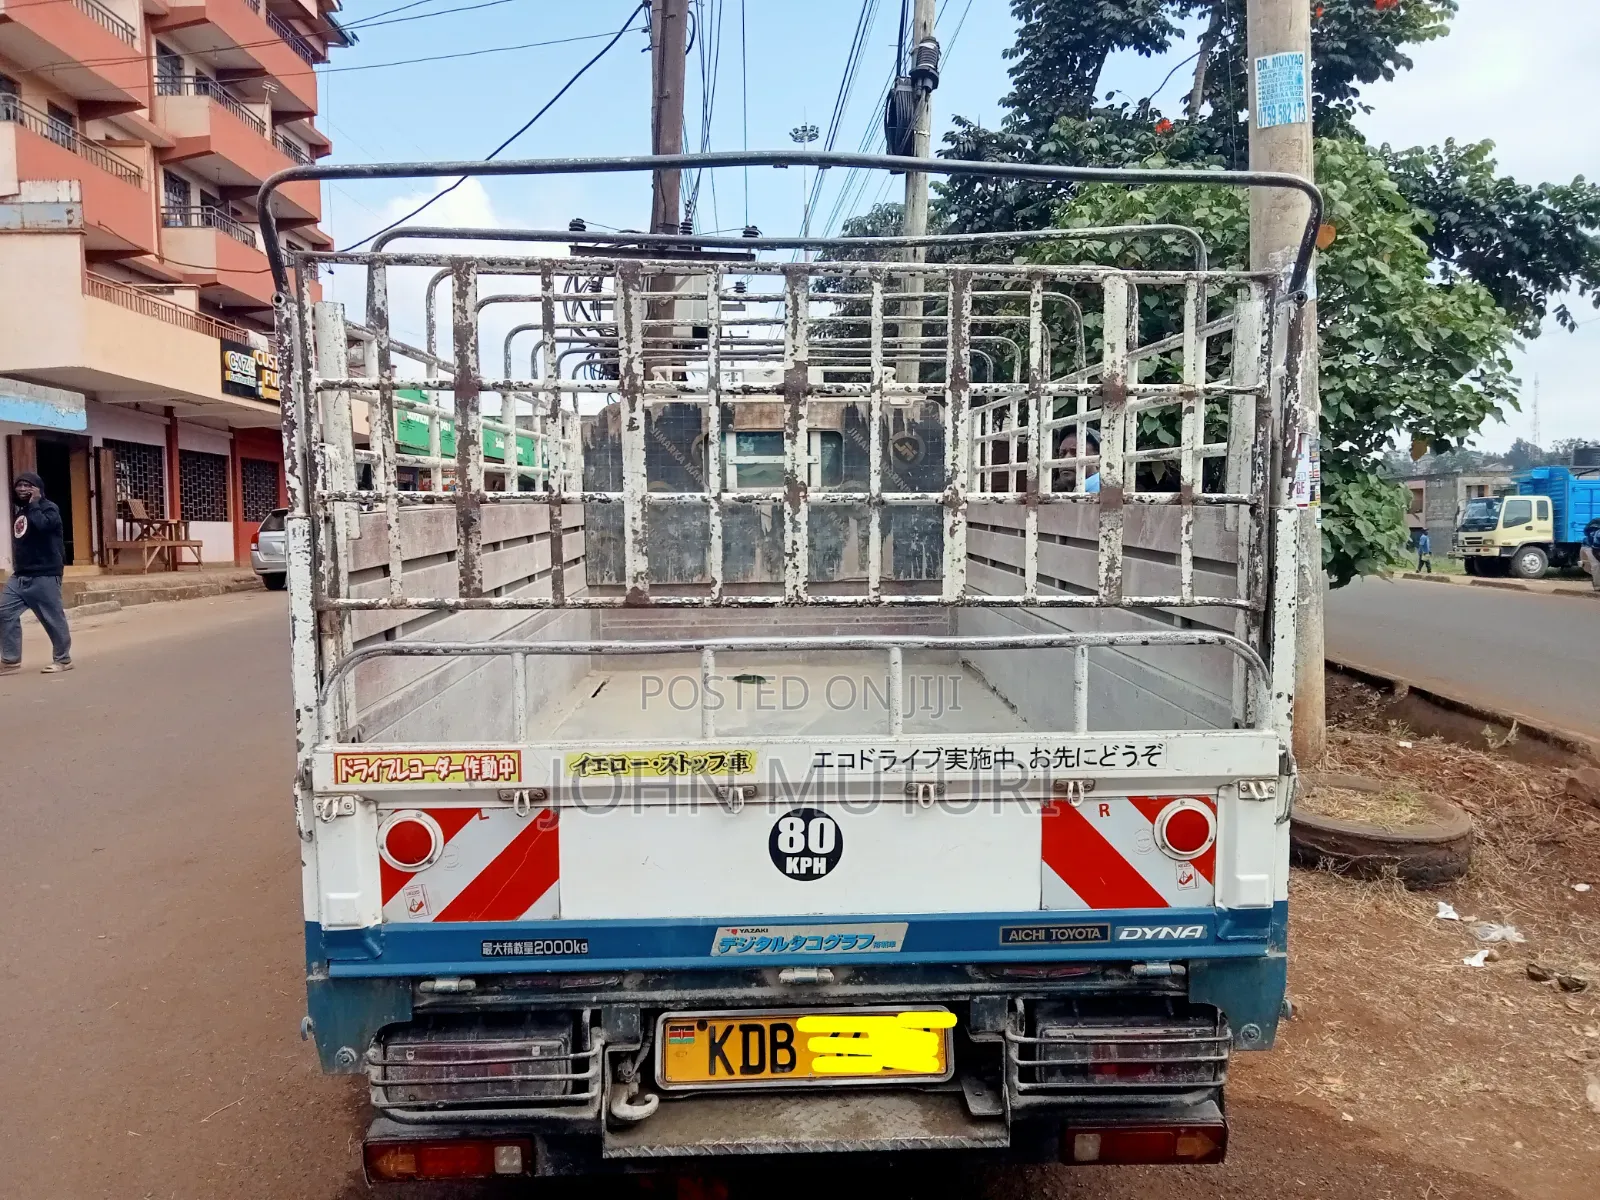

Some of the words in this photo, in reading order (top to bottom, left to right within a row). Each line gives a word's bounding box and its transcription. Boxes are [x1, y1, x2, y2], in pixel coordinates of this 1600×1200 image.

[1257, 59, 1270, 71] DR.
[1272, 54, 1303, 68] MUNYAO
[1258, 104, 1276, 126] 0759
[1279, 103, 1292, 124] 582
[255, 350, 278, 371] CUST
[650, 427, 686, 464] JIMARKA
[1098, 803, 1111, 818] R
[777, 816, 837, 854] 80
[785, 856, 827, 875] KPH
[1008, 929, 1045, 941] AICHI
[1050, 928, 1101, 940] TOYOTA
[1119, 925, 1204, 939] DYNA
[482, 940, 589, 955] 最大積載量2000kg
[708, 1023, 797, 1076] KDB
